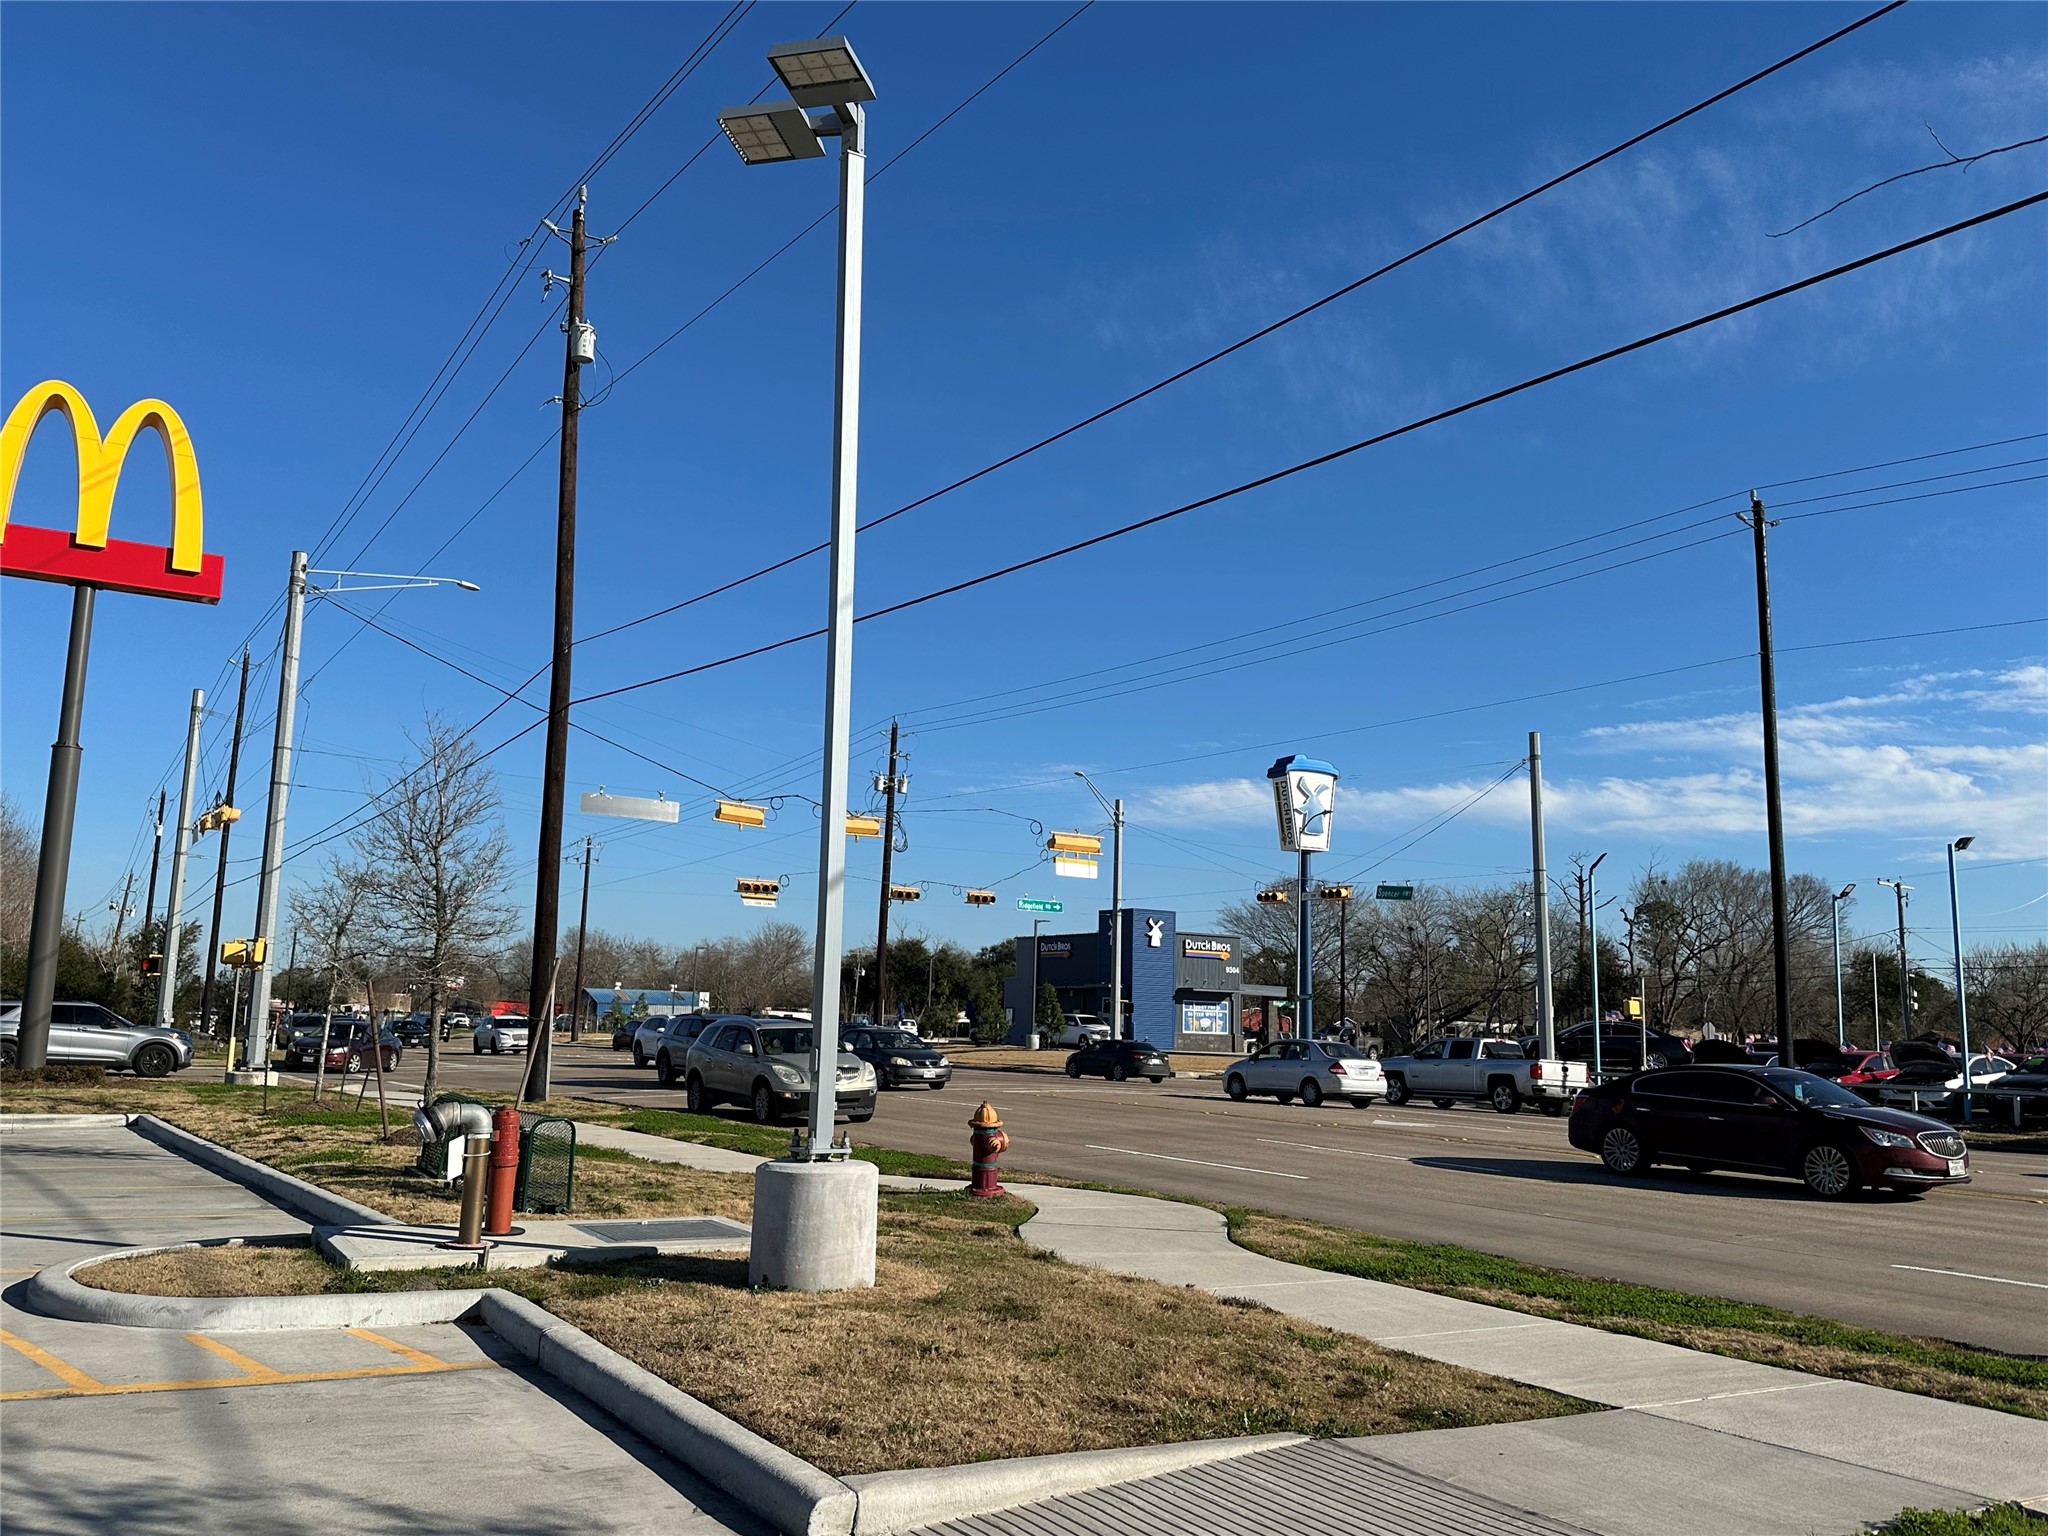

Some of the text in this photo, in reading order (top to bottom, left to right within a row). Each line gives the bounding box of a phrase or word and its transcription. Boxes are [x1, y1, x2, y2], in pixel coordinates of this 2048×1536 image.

[1280, 780, 1294, 846] DUTCH BROS
[1377, 887, 1400, 898] Spencer
[1018, 900, 1044, 910] Ridgefield
[1041, 941, 1071, 951] DUTCH BROS
[1185, 939, 1231, 952] DUTCH BROS
[1225, 966, 1240, 974] 9304
